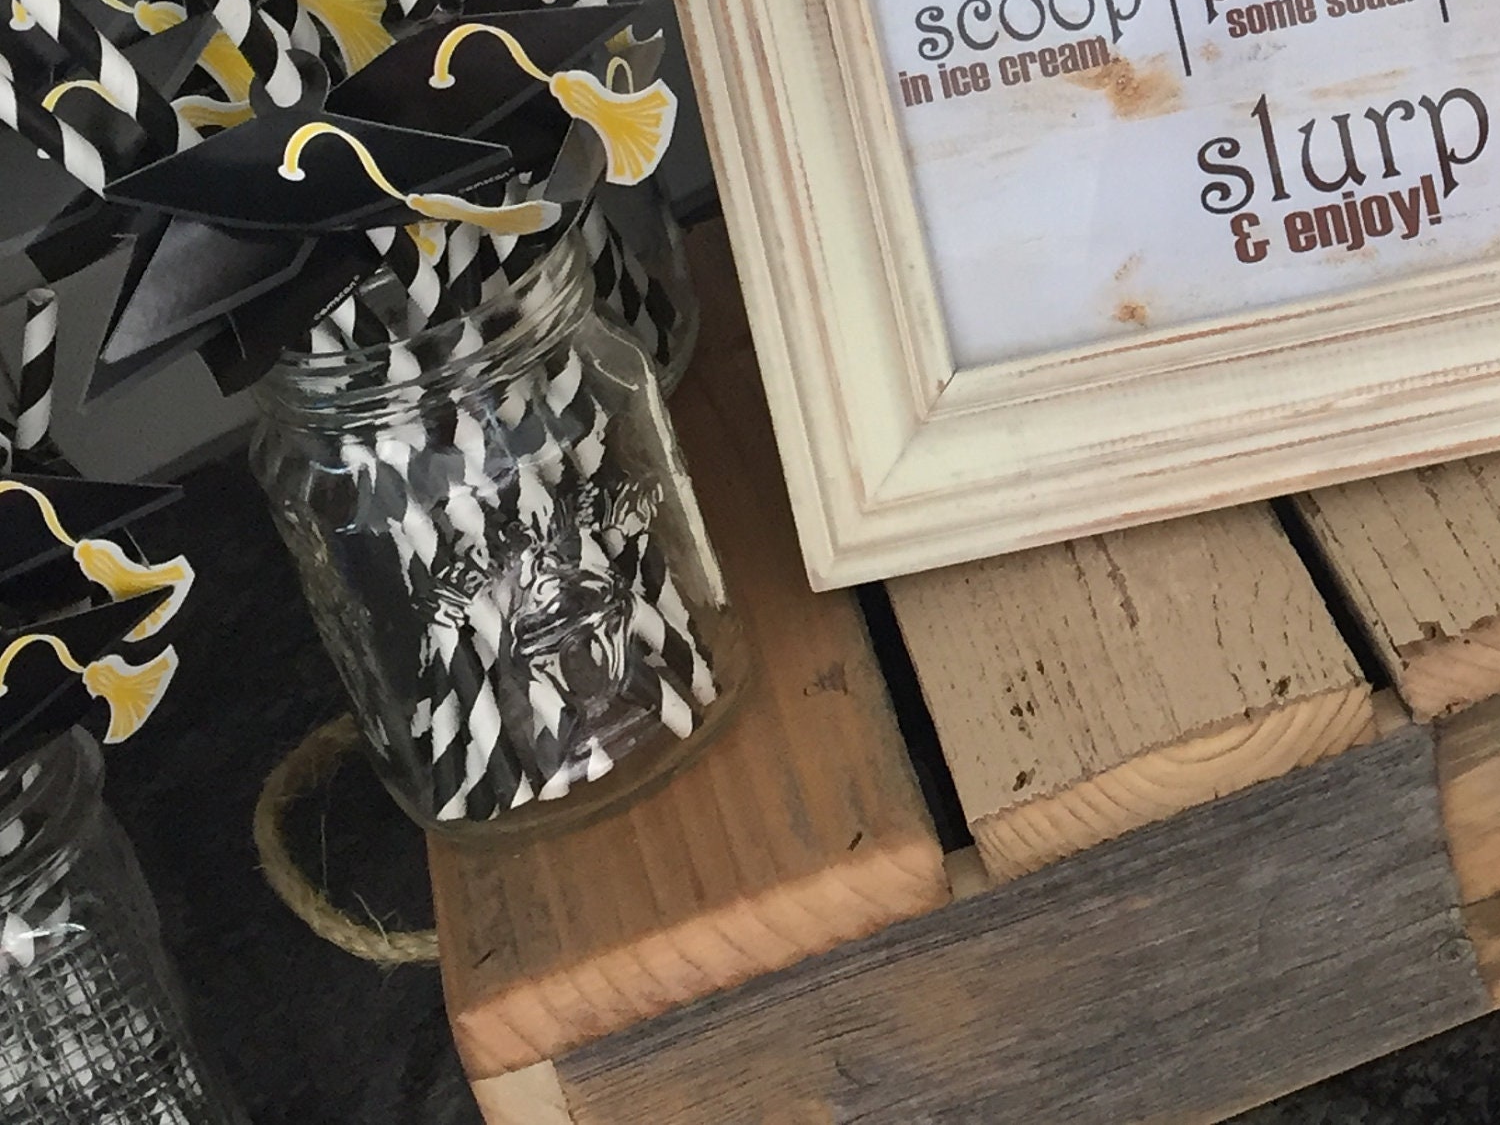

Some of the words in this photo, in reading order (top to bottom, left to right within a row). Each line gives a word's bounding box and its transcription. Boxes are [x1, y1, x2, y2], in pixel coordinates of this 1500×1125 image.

[899, 71, 933, 108] in
[938, 63, 991, 100] ice
[1197, 86, 1490, 214] slurp
[1230, 211, 1270, 264] &
[1284, 174, 1442, 253] enjoy!
